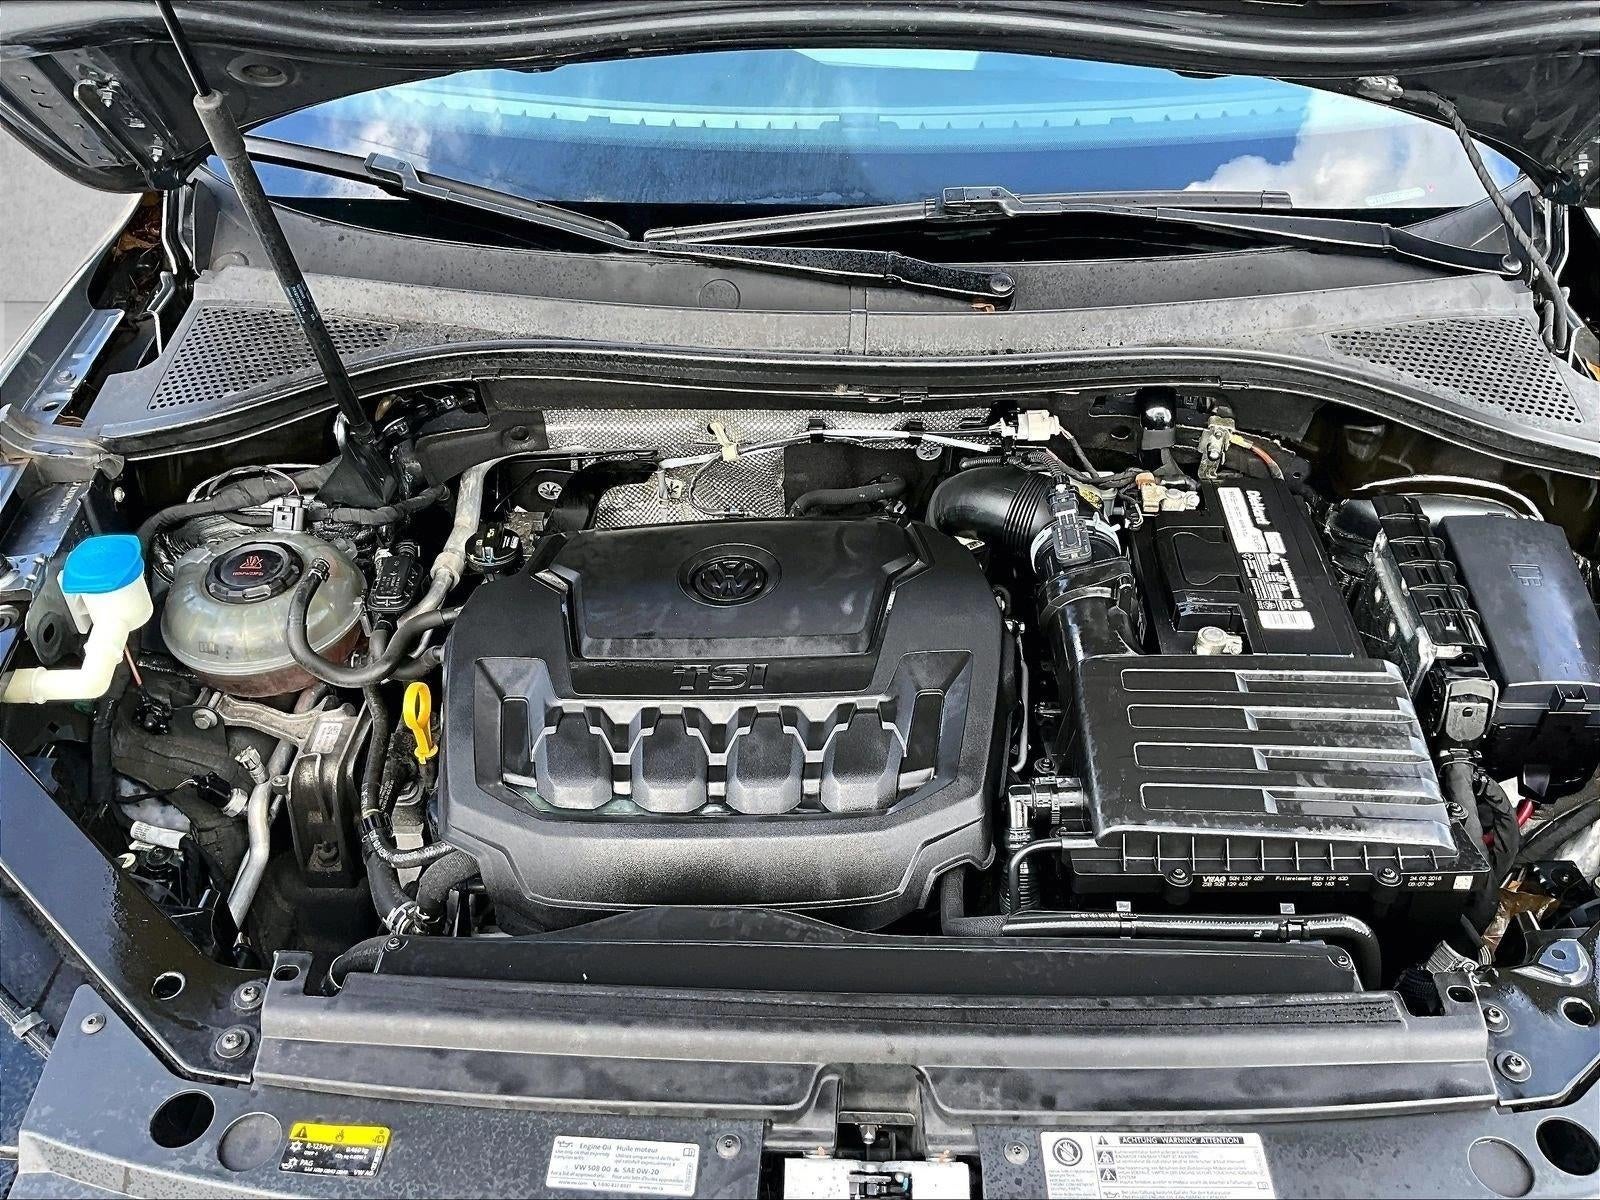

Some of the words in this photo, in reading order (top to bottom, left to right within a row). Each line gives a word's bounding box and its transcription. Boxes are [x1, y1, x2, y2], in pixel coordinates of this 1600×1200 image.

[672, 662, 769, 691] TSI
[580, 1143, 601, 1151] Engine
[616, 1144, 633, 1152] Huile
